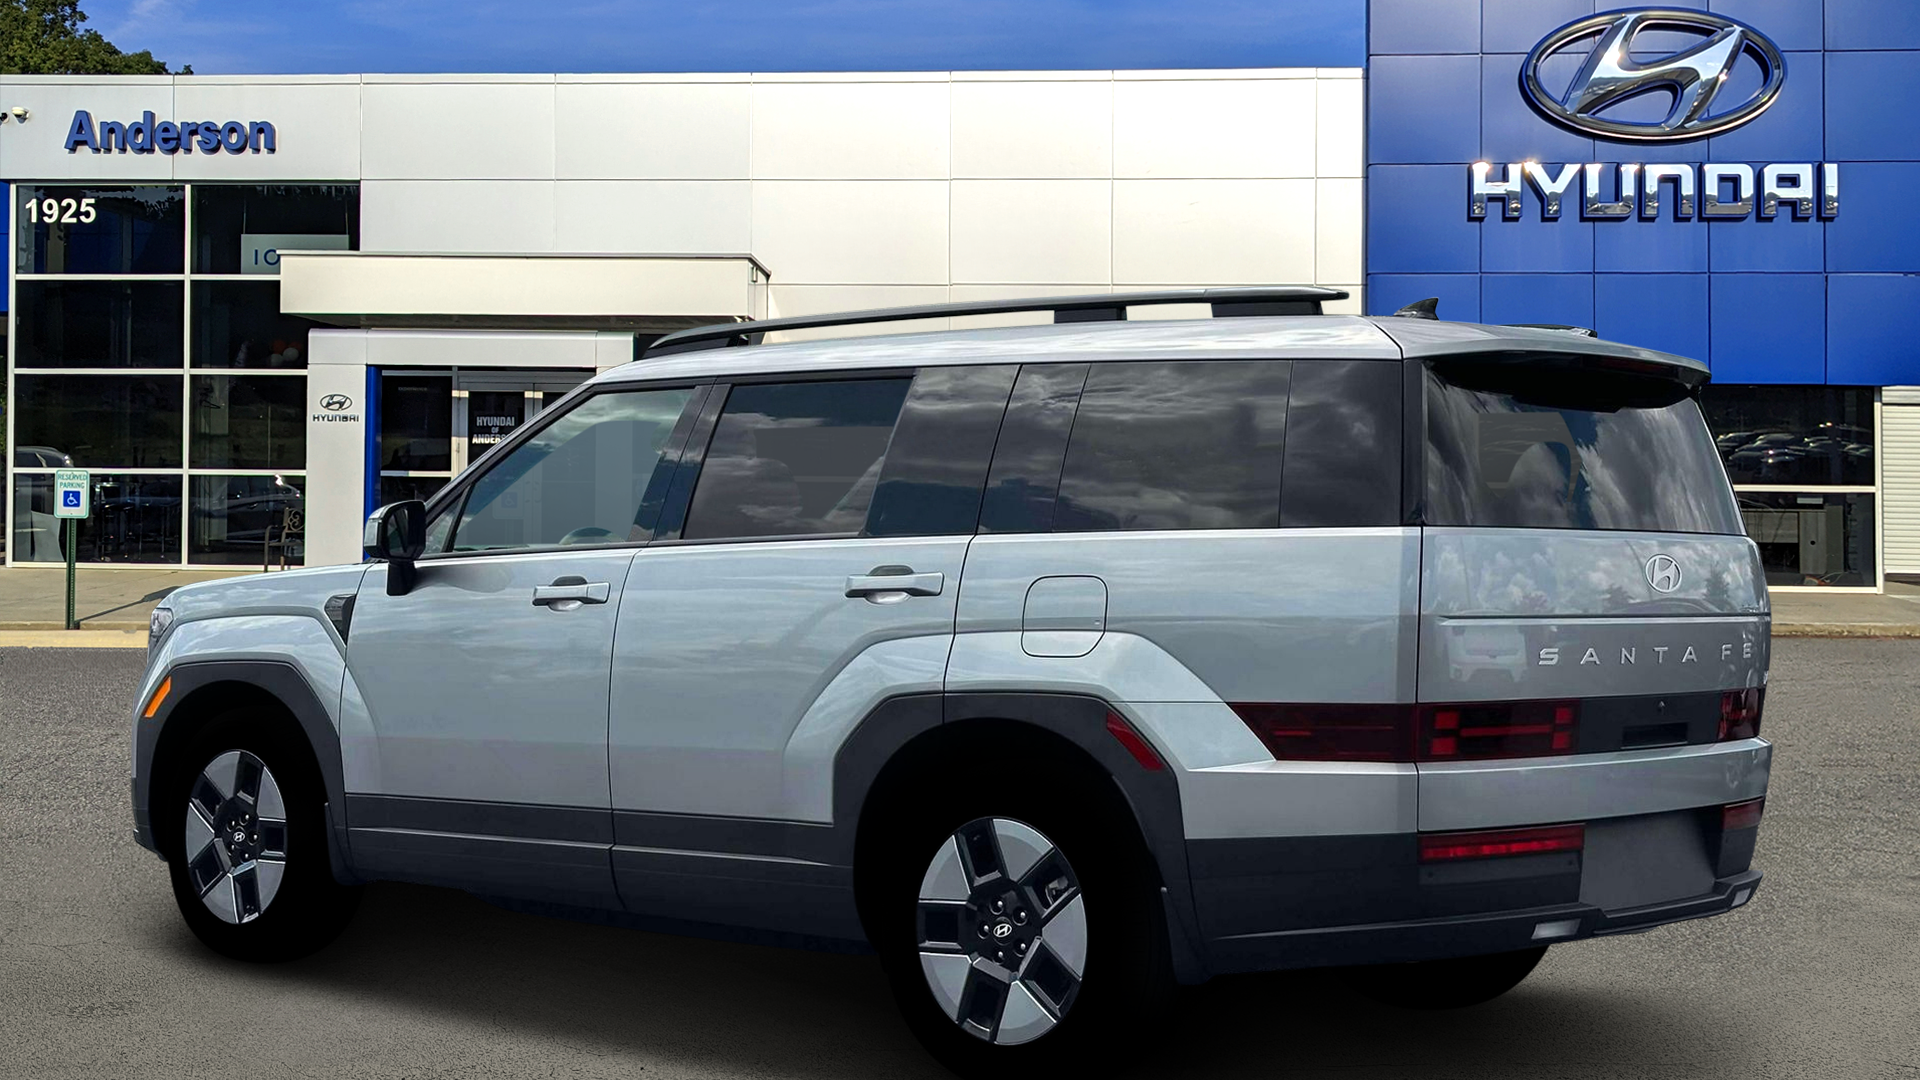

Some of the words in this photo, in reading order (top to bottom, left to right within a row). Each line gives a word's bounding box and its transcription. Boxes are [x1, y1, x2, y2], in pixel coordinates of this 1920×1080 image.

[65, 110, 277, 154] Anderson
[1467, 161, 1839, 220] HYUNDAI
[24, 199, 96, 223] 1925
[312, 414, 359, 422] HYUNDAI
[476, 416, 515, 426] HYUNDAI
[1538, 646, 1698, 666] SANTA
[1721, 642, 1752, 662] FE
